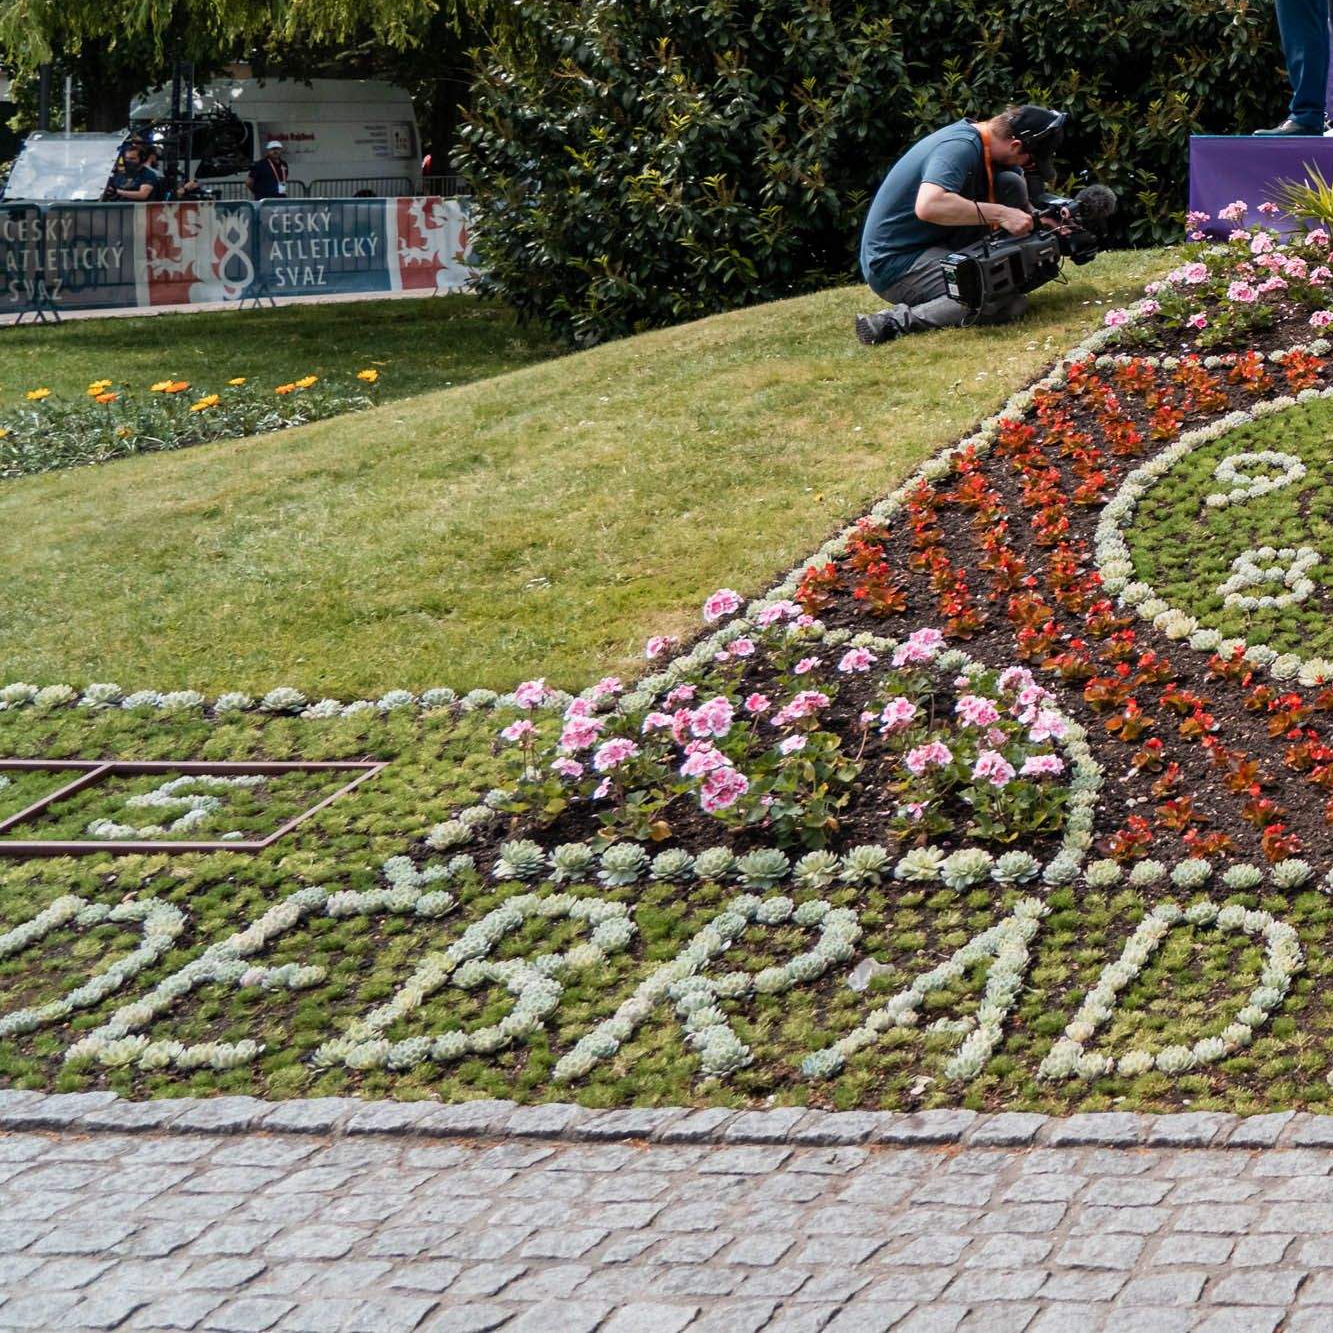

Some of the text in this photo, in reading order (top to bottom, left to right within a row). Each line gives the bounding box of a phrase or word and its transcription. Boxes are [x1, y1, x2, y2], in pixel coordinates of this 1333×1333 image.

[269, 206, 332, 233] ČESKÝ
[6, 241, 124, 272] ATLETICKÝ
[270, 230, 379, 261] ATLETICKÝ
[9, 277, 63, 302] SVAZ
[275, 265, 328, 287] SVAZ
[1205, 448, 1307, 508] 9
[1215, 546, 1322, 611] 8
